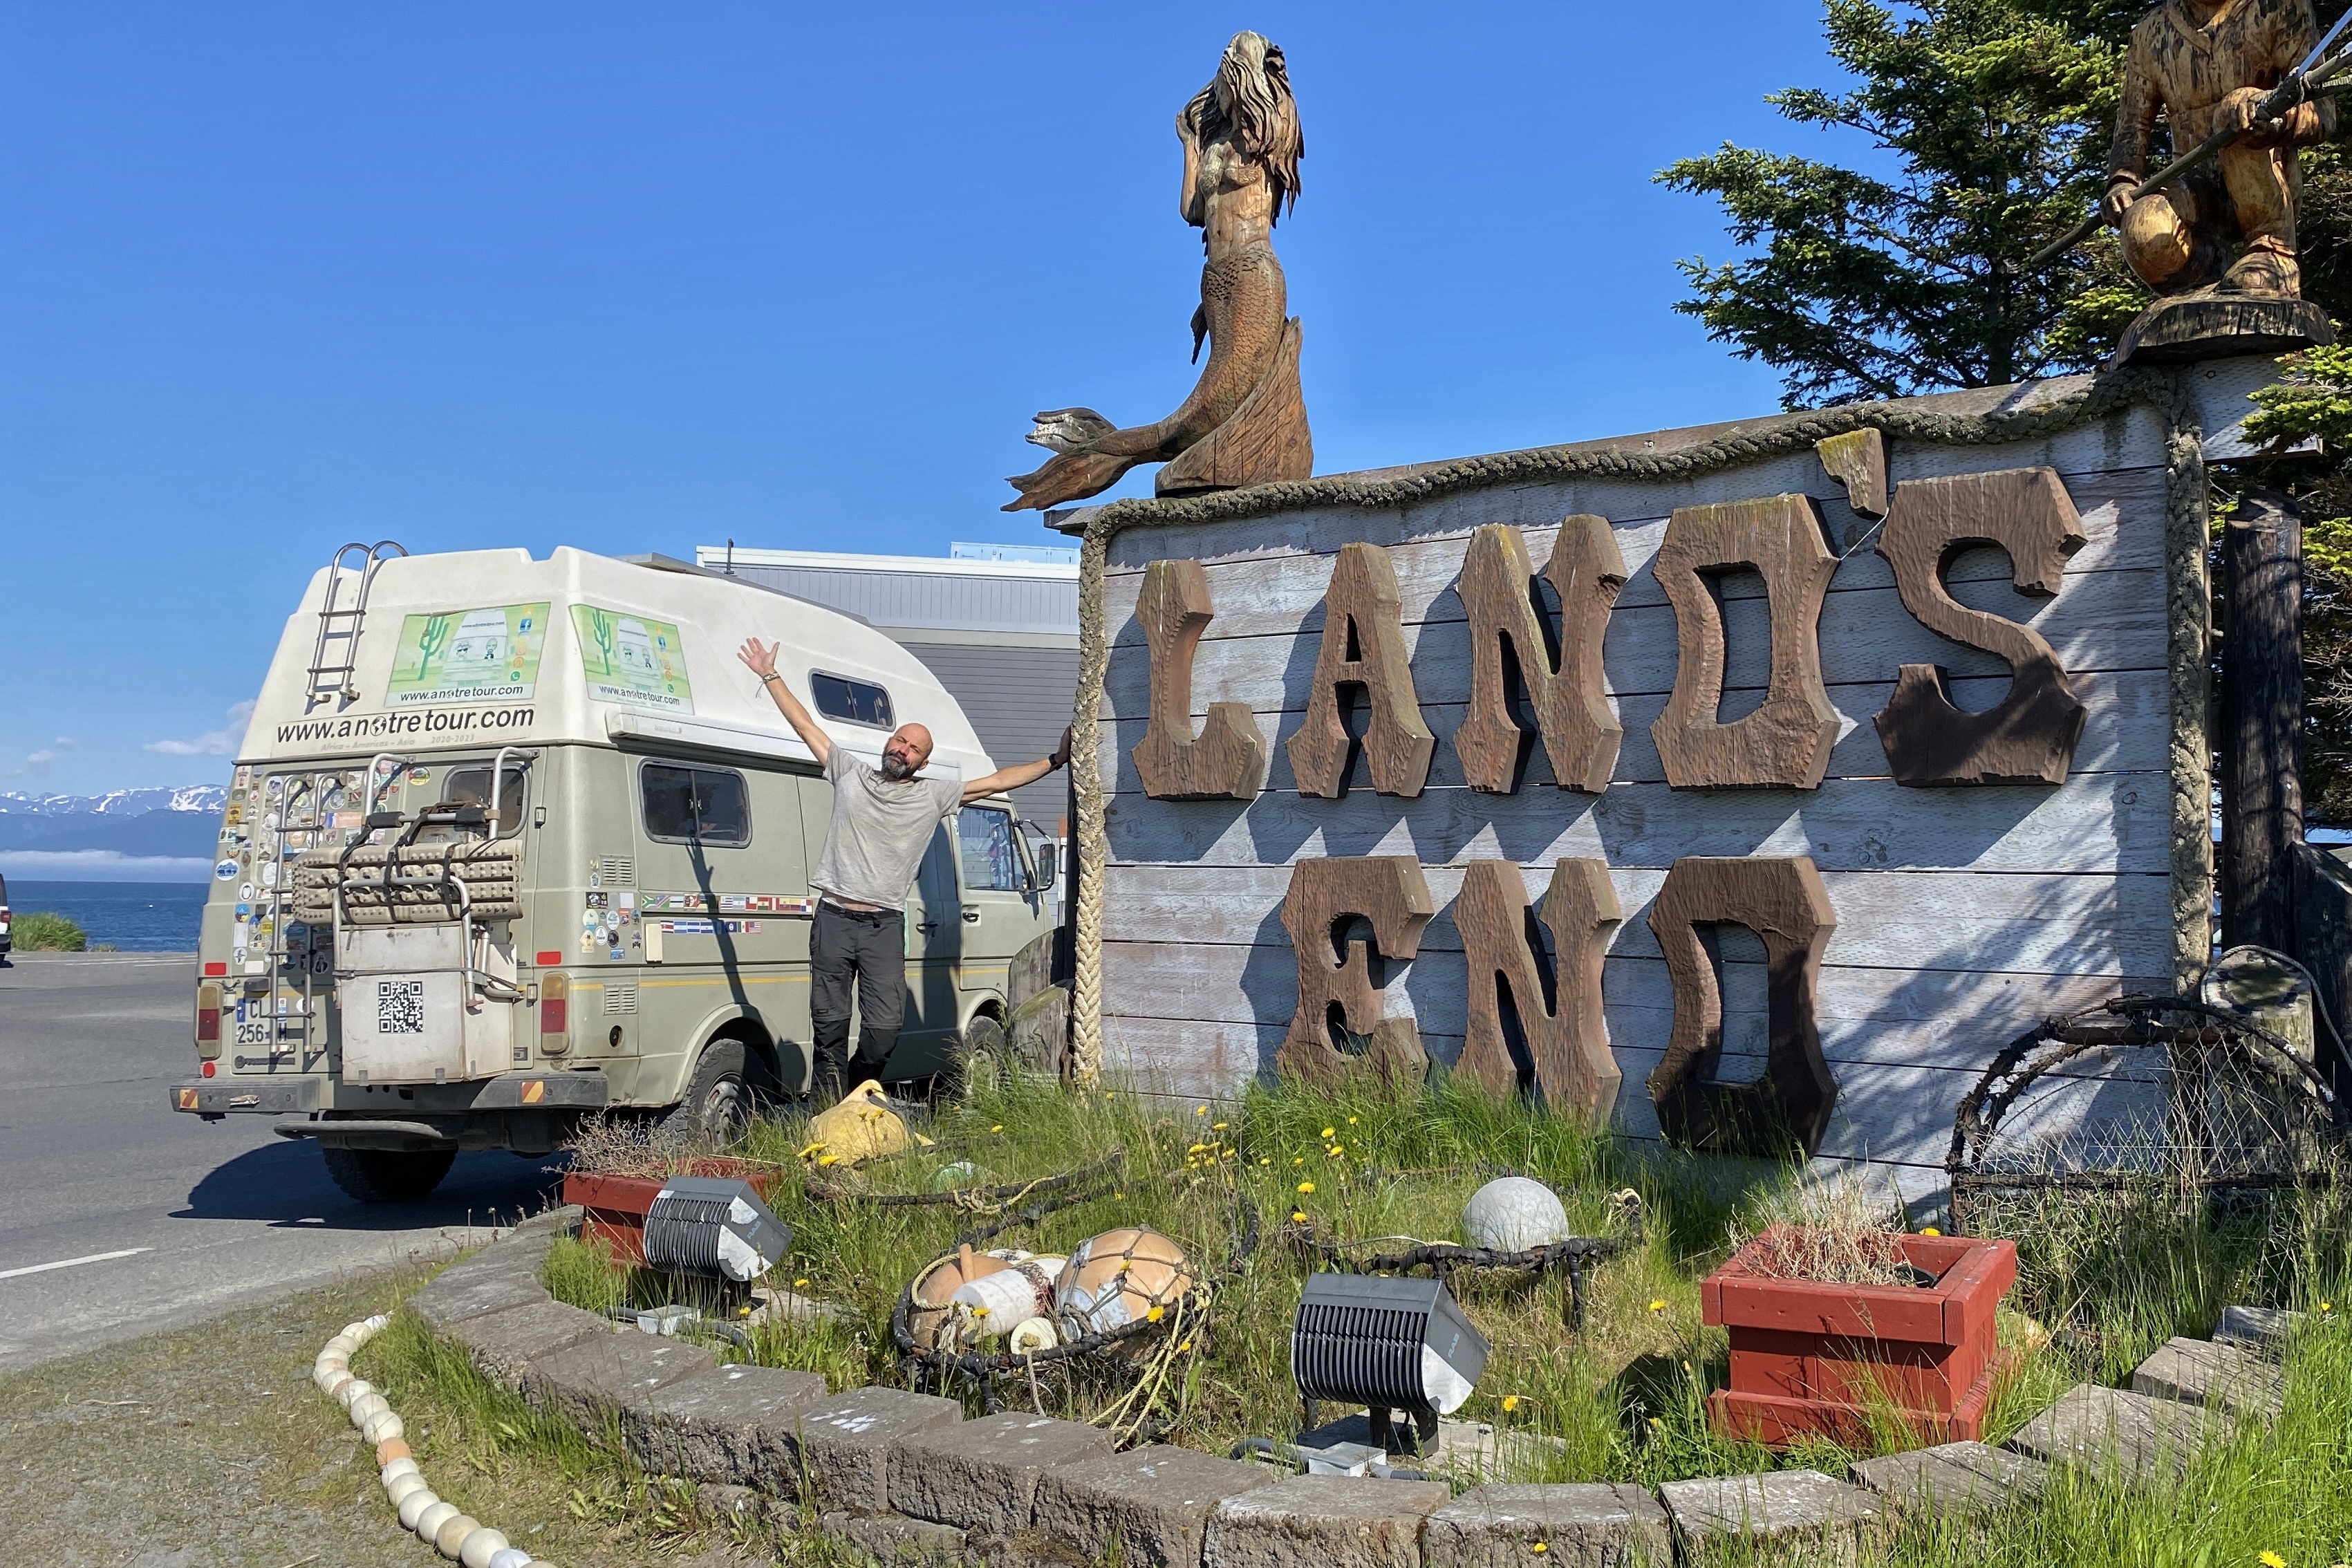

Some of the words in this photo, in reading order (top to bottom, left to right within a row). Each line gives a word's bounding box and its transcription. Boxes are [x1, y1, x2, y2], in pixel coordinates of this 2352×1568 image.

[1131, 427, 2089, 801] LAND'S
[320, 743, 344, 752] Africa
[397, 738, 415, 746] Asia
[1276, 855, 1839, 1159] END
[747, 1220, 761, 1240] RAB
